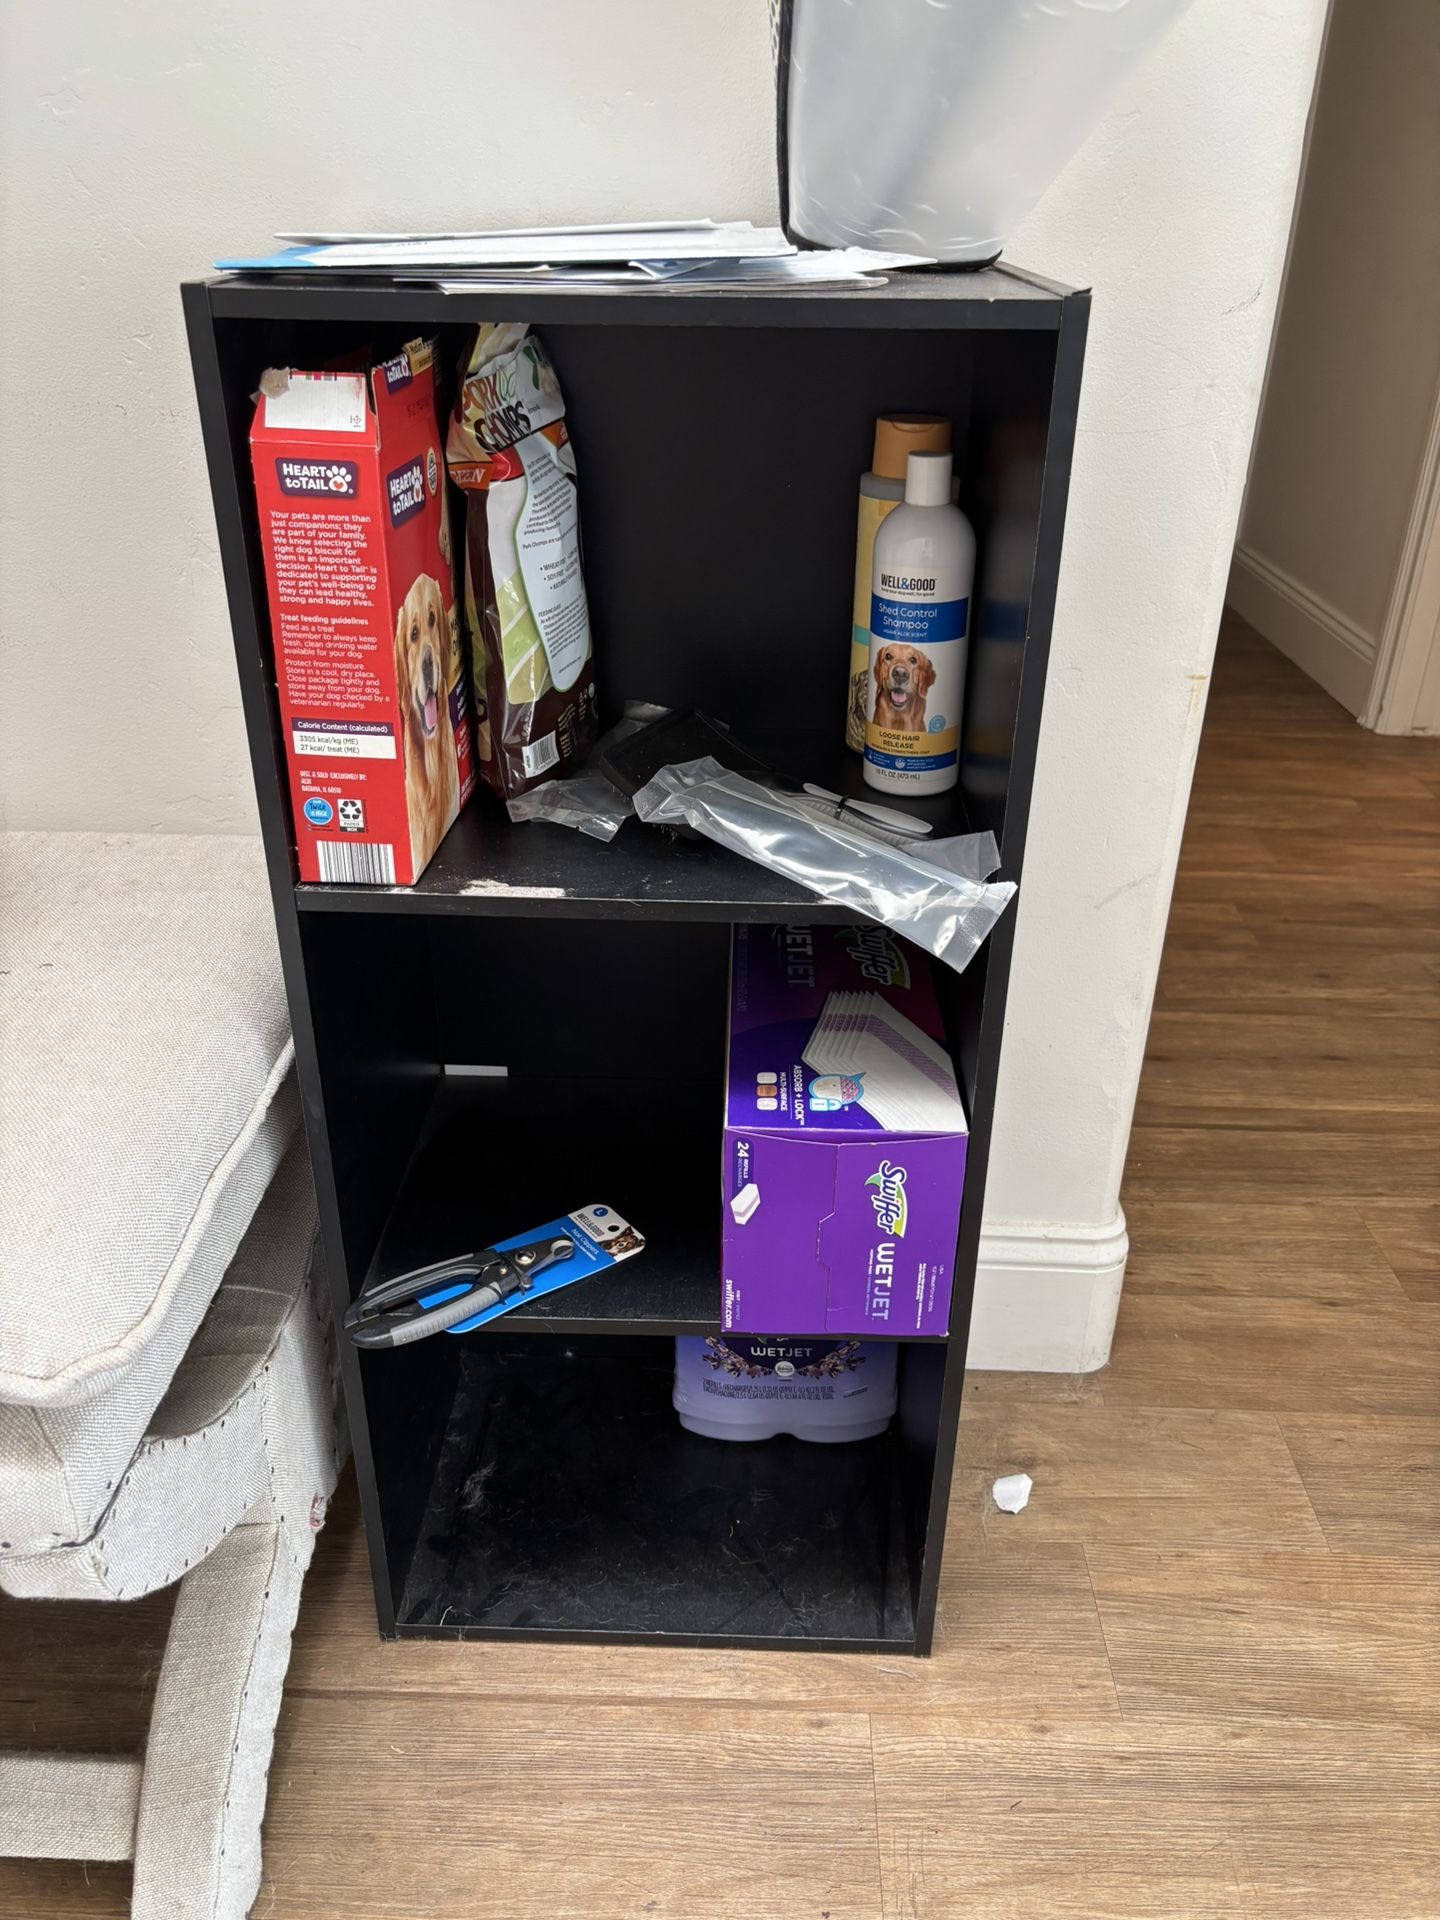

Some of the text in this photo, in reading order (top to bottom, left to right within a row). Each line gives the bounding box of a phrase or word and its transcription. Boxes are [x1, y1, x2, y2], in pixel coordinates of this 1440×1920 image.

[474, 401, 531, 453] CHOMPS
[283, 463, 327, 477] HEART
[390, 471, 411, 498] HEART
[270, 511, 289, 519] Your
[271, 519, 362, 532] just companions; they
[288, 529, 305, 537] part
[339, 532, 366, 540] family.
[314, 539, 351, 548] selecting
[296, 547, 312, 555] dog
[276, 562, 312, 570] decision.
[277, 571, 318, 579] dedicated
[332, 574, 376, 582] supporting
[881, 573, 935, 590] WELL&GOOD
[321, 581, 364, 590] well-being
[279, 587, 296, 595] they
[335, 590, 367, 599] healthy,
[280, 596, 306, 604] strong
[326, 598, 351, 606] happy
[879, 603, 937, 617] Shed Control
[301, 615, 328, 624] feeding
[331, 617, 368, 625] guidelines
[883, 616, 928, 631] Shampoo
[333, 634, 357, 642] always
[359, 635, 377, 643] keep
[326, 642, 355, 650] drinking
[285, 659, 311, 667] Protect
[313, 660, 330, 668] from
[309, 676, 338, 684] package
[341, 677, 363, 685] tightly
[290, 698, 331, 707] veterinarian
[342, 693, 372, 701] checked
[374, 694, 383, 702] by
[349, 724, 388, 733] (calculated)
[879, 731, 900, 740] LOOSE
[317, 737, 341, 745] kcal/kg
[883, 740, 914, 749] RELEASE
[793, 1065, 803, 1092] ABSORB
[780, 1072, 788, 1111] MULTI-SURFACE
[737, 1141, 749, 1157] 24
[871, 1160, 907, 1235] Swiffer
[872, 1243, 895, 1320] WETJET
[725, 1279, 734, 1328] swiffer.com
[750, 1346, 813, 1357] WETJET
